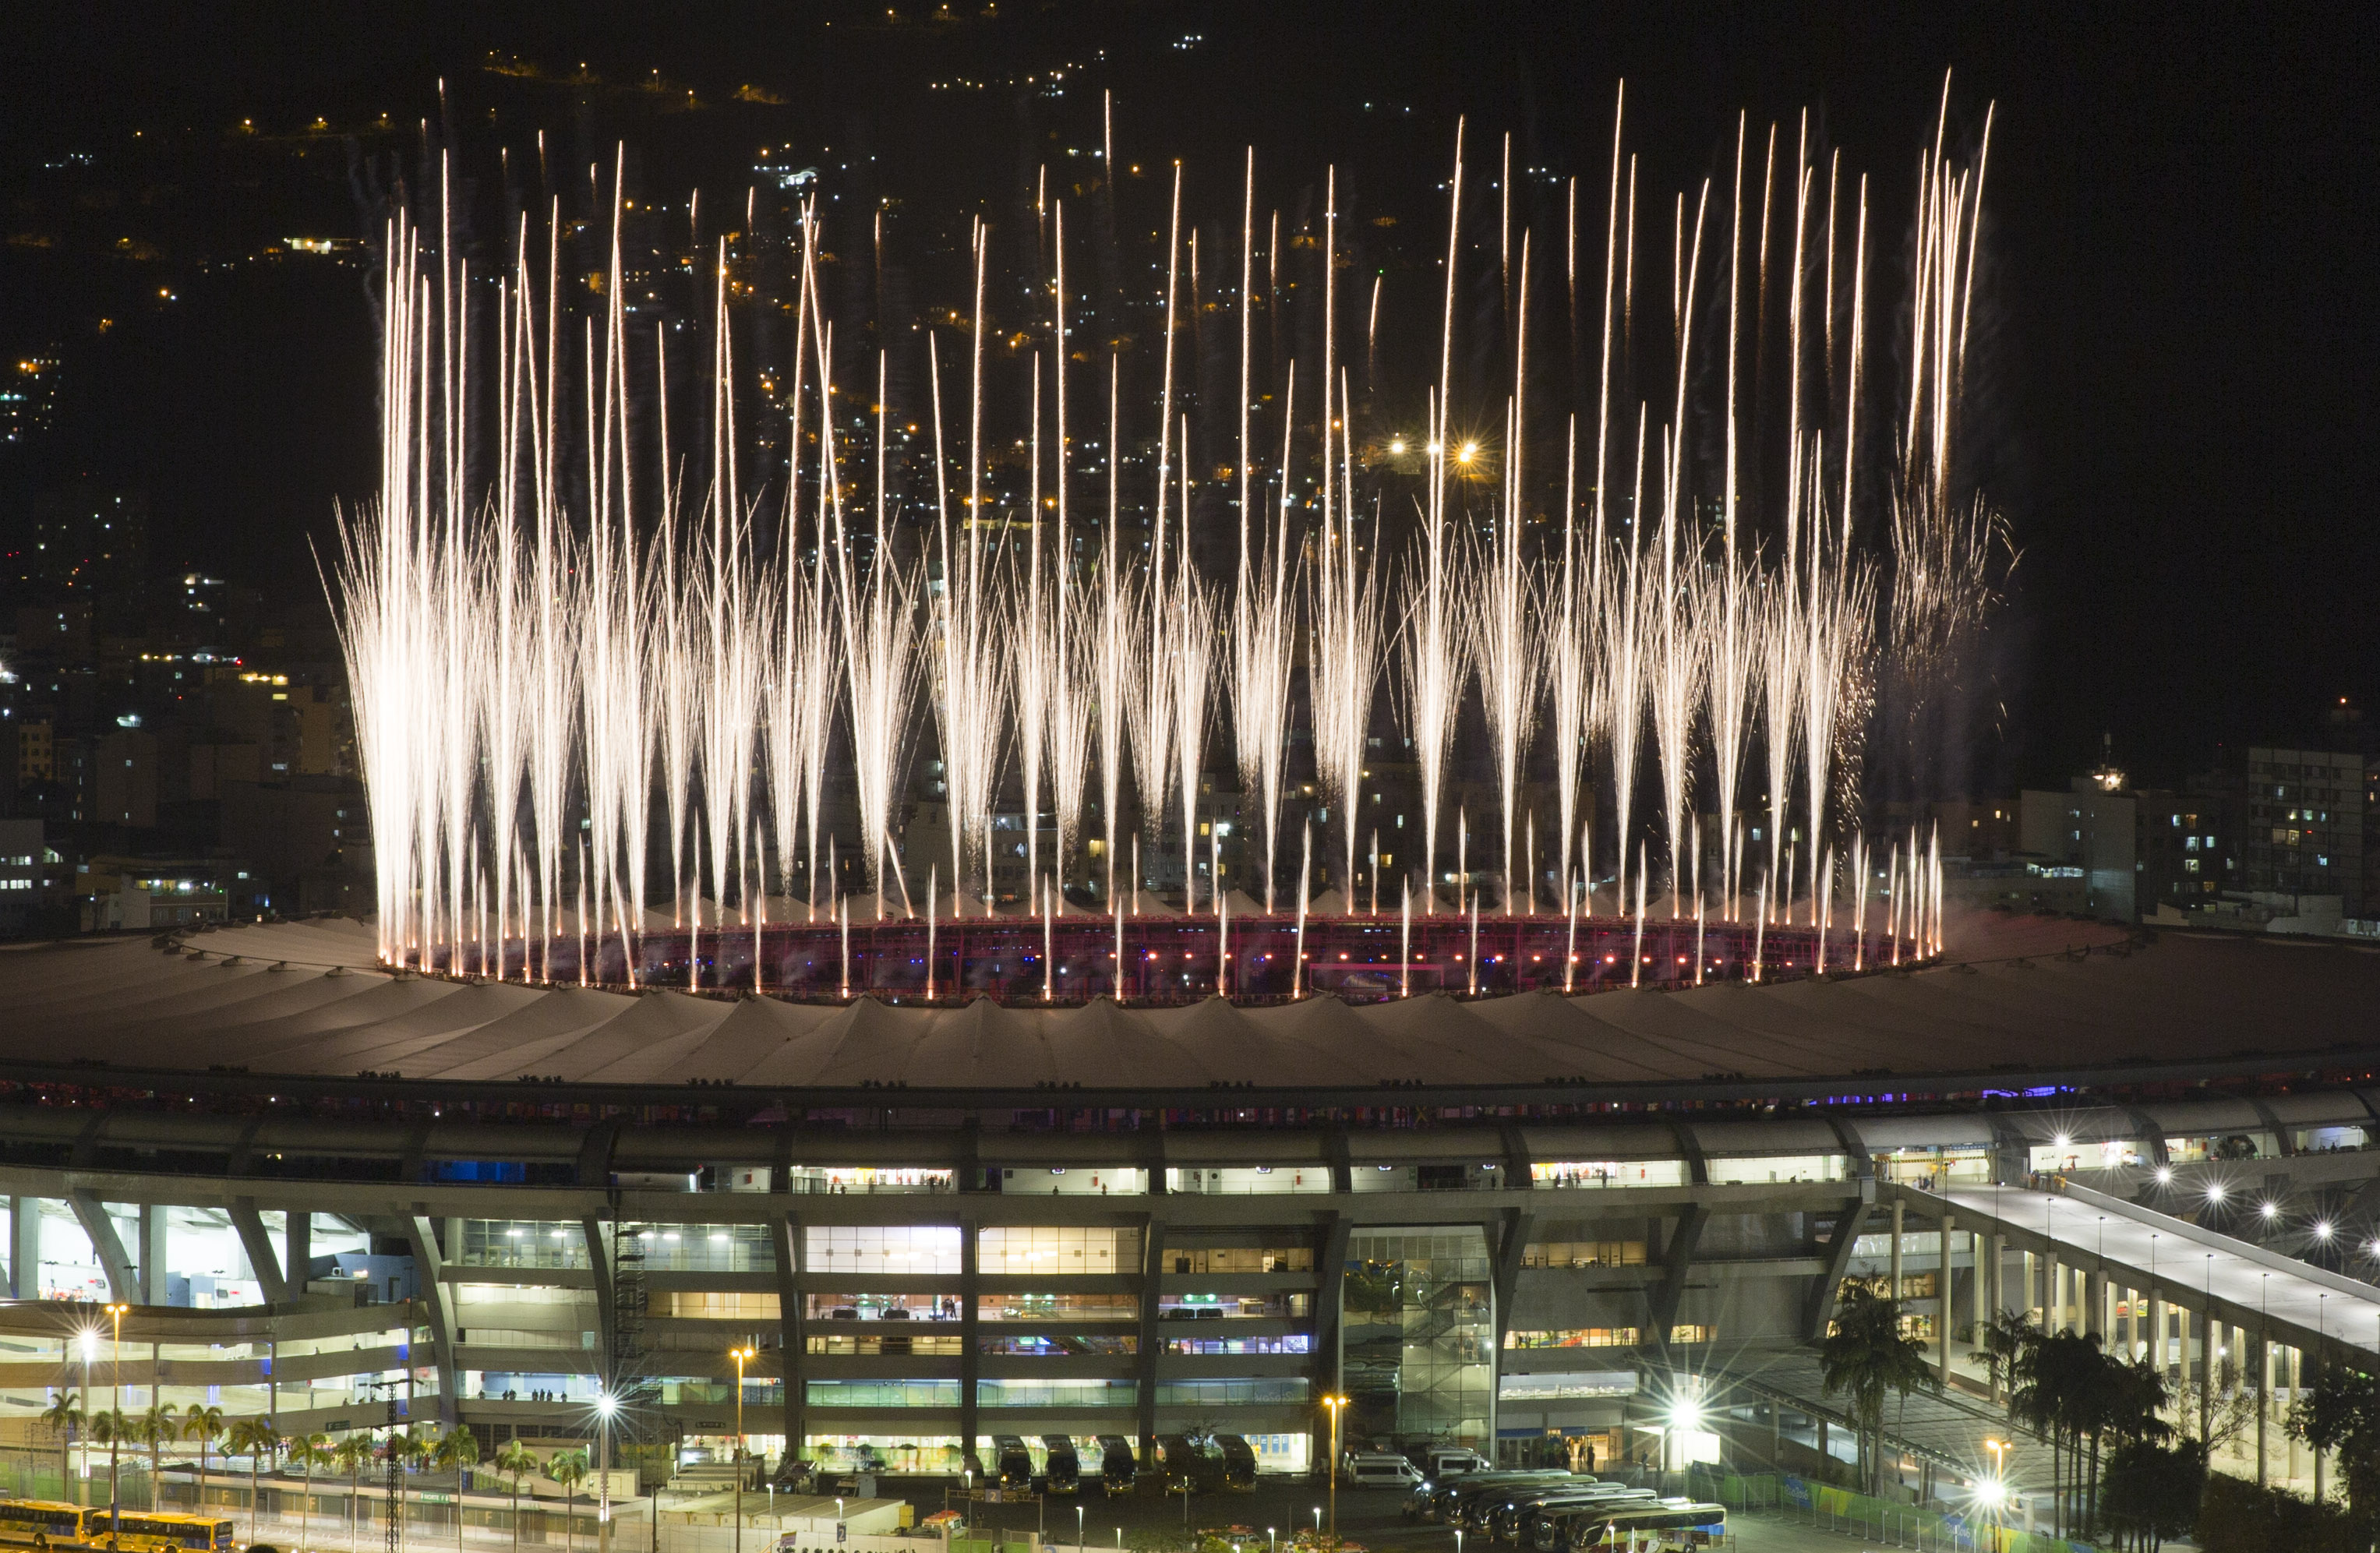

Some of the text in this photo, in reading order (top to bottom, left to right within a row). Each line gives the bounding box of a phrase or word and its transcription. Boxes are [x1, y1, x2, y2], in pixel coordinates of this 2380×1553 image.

[223, 1444, 233, 1456] F
[221, 1490, 230, 1503] F
[990, 1491, 997, 1502] 2
[309, 1497, 316, 1510] F
[485, 1511, 493, 1524] F
[577, 1518, 584, 1532] F
[839, 1528, 844, 1540] 2
